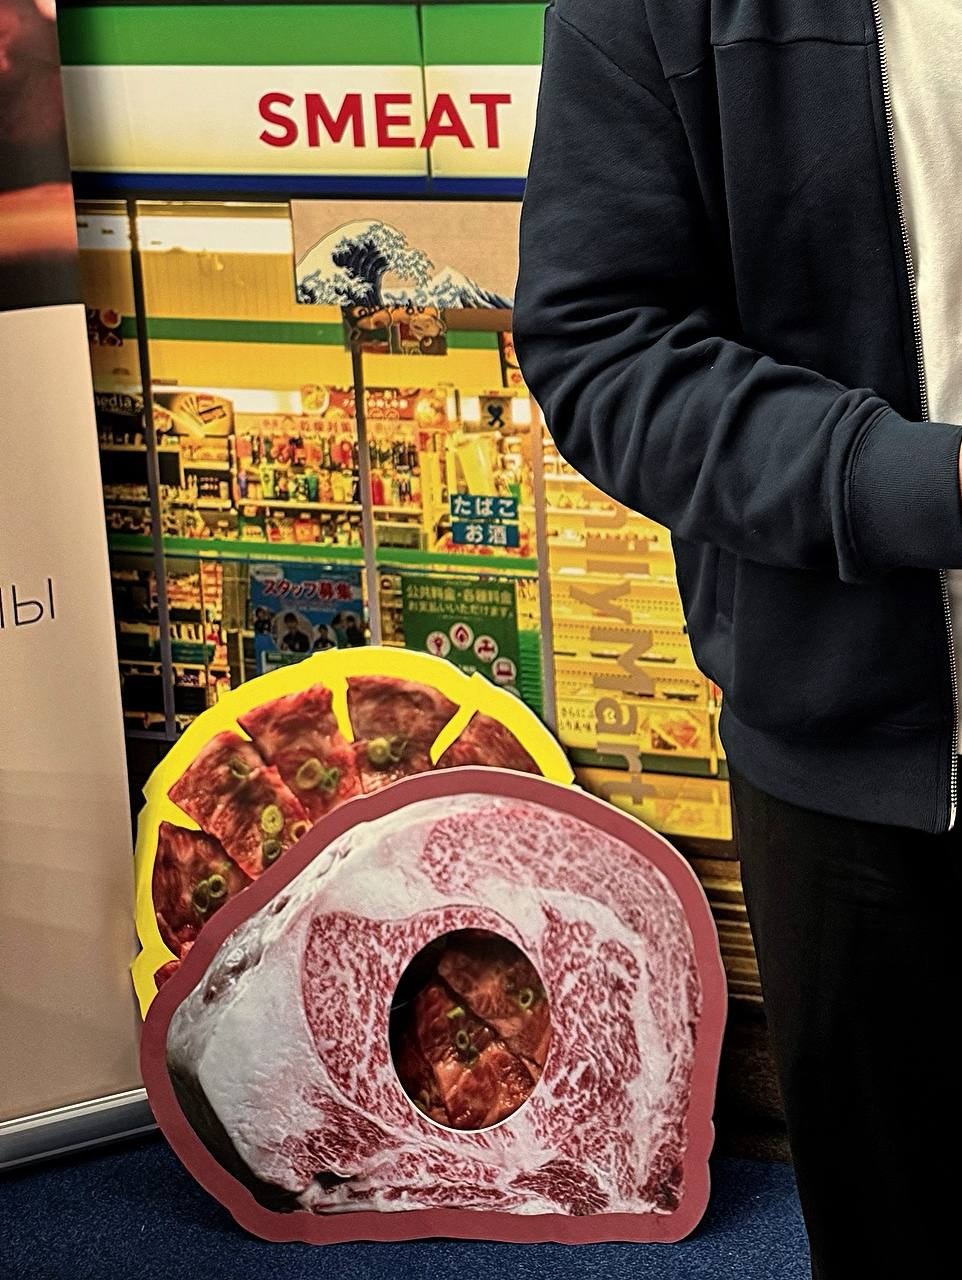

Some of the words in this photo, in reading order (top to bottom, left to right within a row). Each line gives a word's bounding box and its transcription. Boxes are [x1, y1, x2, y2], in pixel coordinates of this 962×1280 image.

[258, 92, 512, 149] SMEAT
[453, 496, 515, 517] たばこ
[466, 524, 507, 545] お酒
[0, 577, 55, 629] ы
